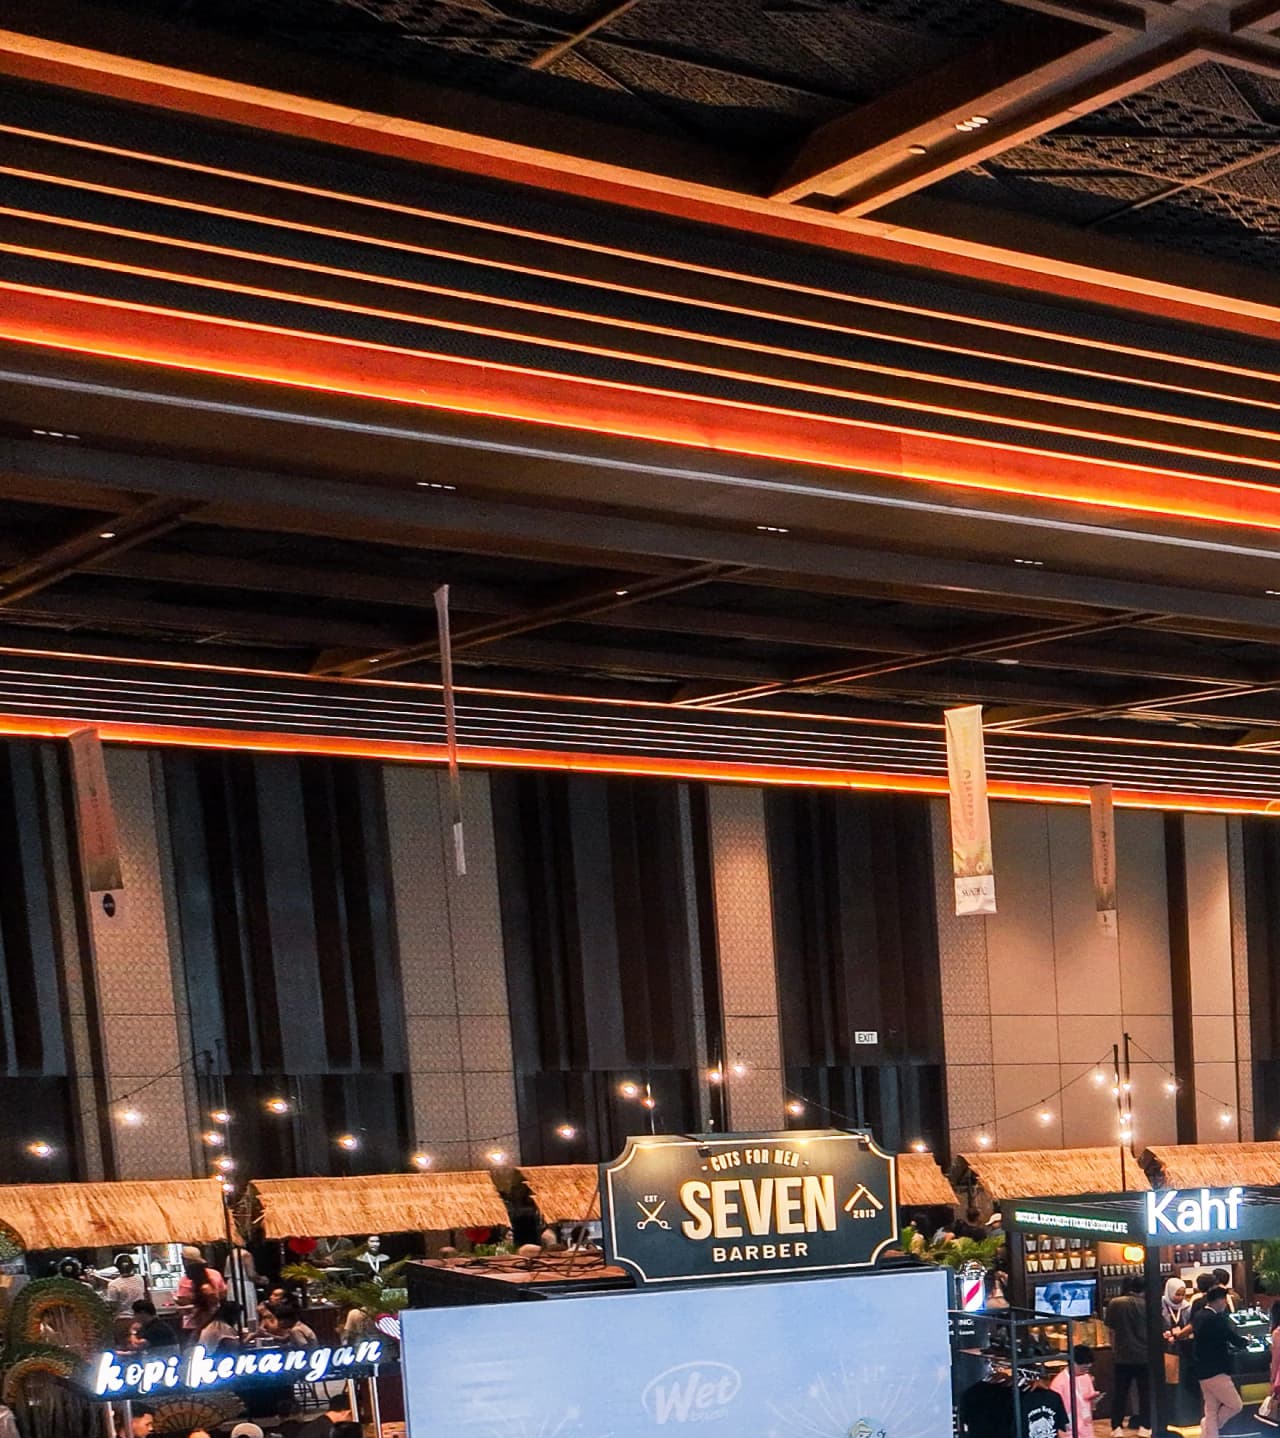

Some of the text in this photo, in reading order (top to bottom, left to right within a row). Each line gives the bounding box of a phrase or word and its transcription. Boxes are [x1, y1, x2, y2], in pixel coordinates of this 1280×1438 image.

[710, 1153, 741, 1172] CUTS
[746, 1149, 769, 1164] FOR
[679, 1175, 837, 1241] SEVEN
[1147, 1187, 1245, 1236] Kahf
[713, 1243, 809, 1263] BARBER
[96, 1340, 382, 1395] kopi kenangan
